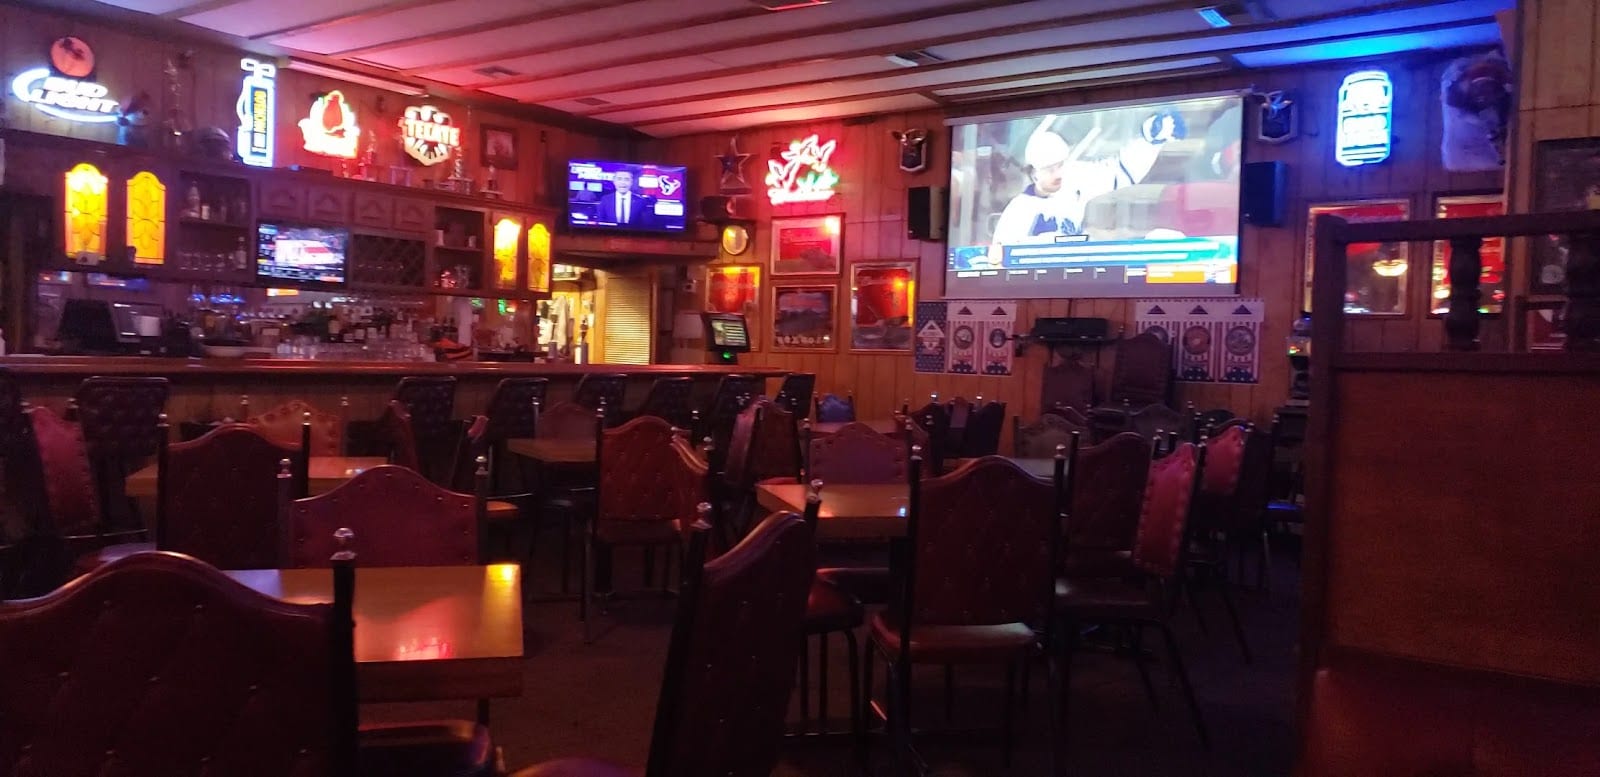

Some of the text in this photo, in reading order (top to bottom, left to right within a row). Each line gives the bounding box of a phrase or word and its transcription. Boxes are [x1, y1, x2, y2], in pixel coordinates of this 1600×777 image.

[43, 76, 108, 98] BUD
[29, 89, 120, 112] LIGHT
[404, 117, 460, 147] TECATE
